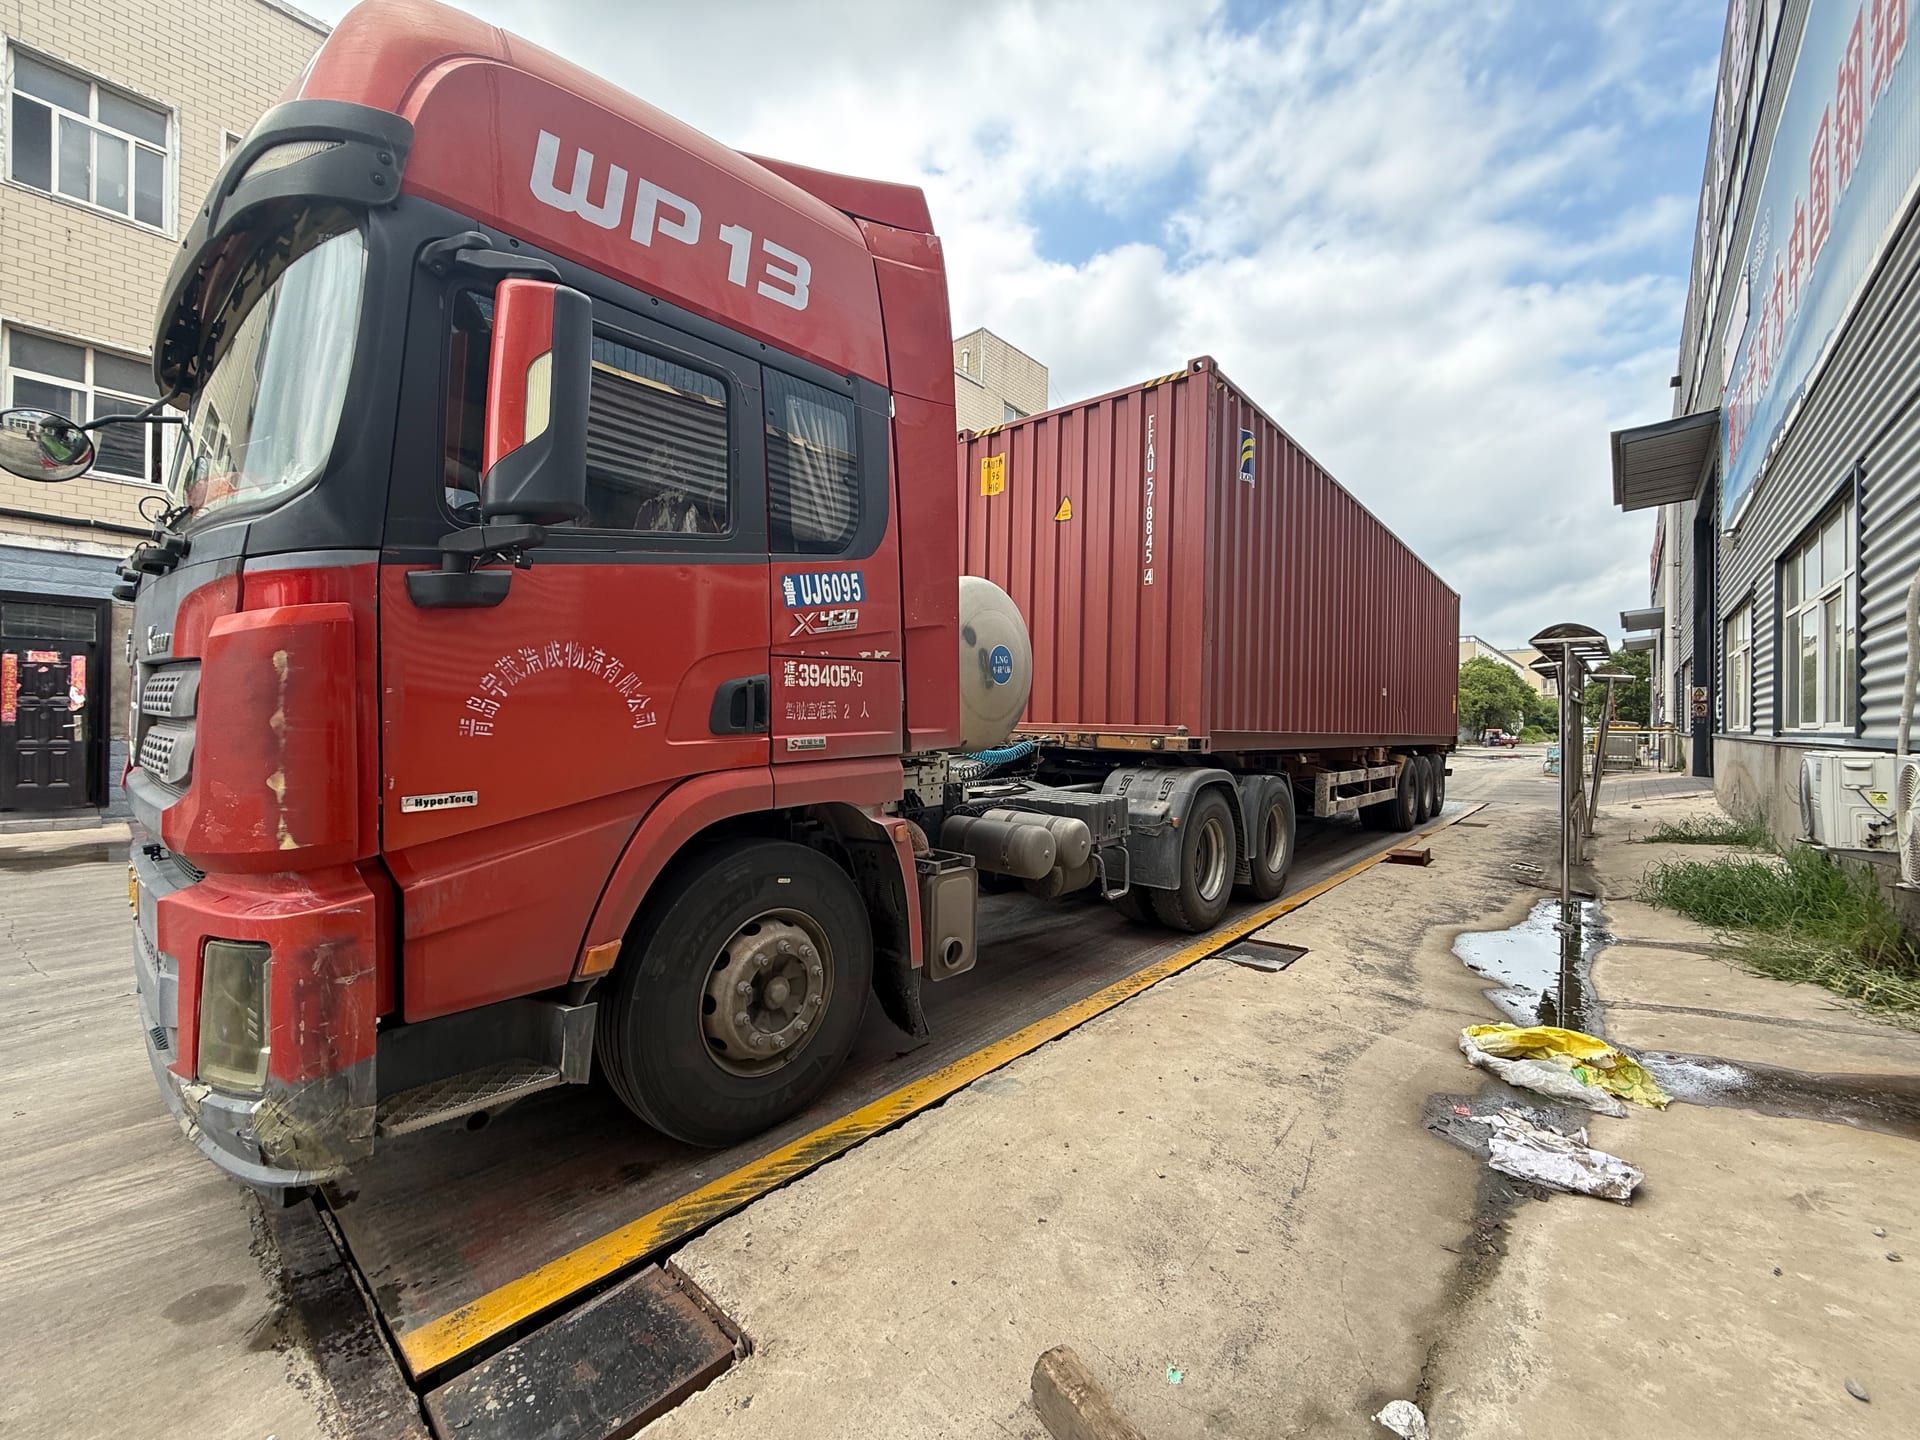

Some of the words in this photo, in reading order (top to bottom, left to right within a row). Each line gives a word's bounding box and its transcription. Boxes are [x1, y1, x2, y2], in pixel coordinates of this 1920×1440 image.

[1146, 415, 1155, 472] FFAU
[1145, 477, 1153, 564] 578845
[1144, 569, 1153, 586] 4
[995, 655, 1009, 665] LNG
[843, 703, 850, 719] 2
[860, 700, 870, 718] 人
[414, 795, 474, 808] HyperTorq
